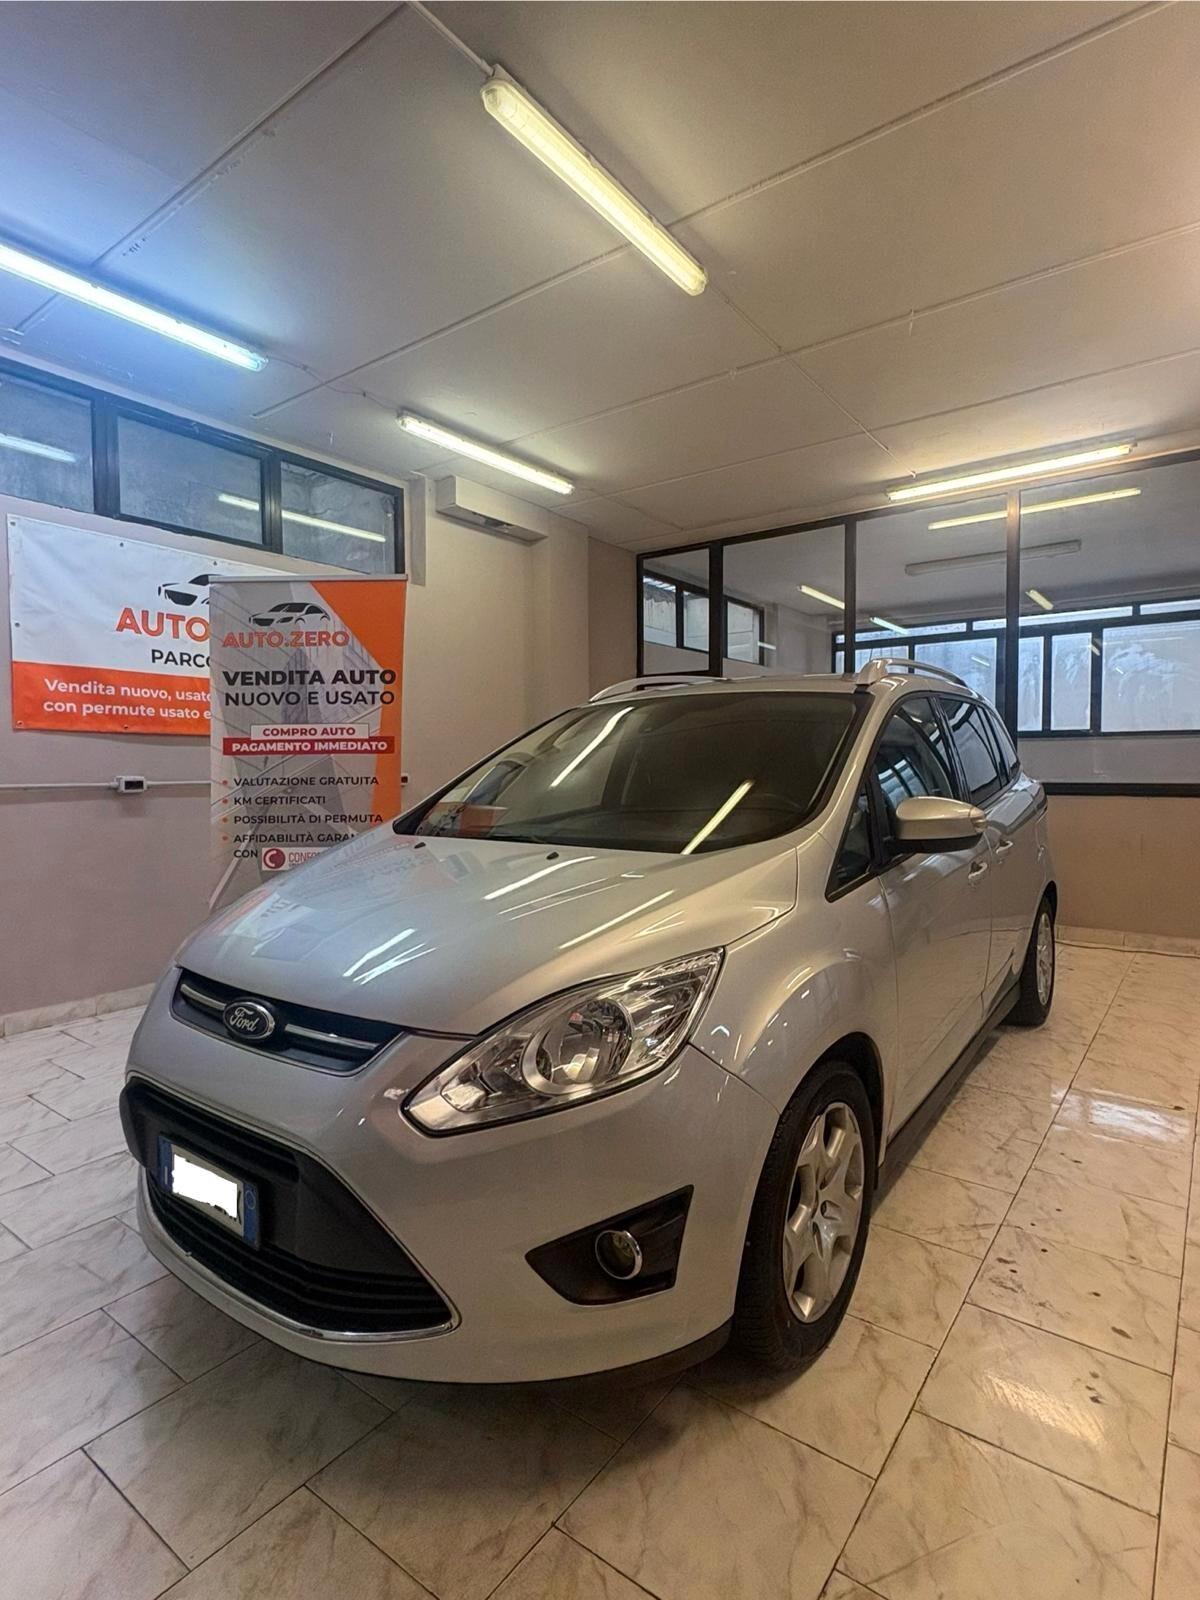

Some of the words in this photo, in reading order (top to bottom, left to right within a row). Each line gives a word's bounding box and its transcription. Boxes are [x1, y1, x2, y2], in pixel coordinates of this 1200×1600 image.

[116, 607, 210, 642] AUTO
[222, 631, 349, 648] AUTO.ZERO
[222, 670, 325, 686] VENDITA
[332, 669, 396, 685] AUTO
[44, 678, 116, 696] Vendita
[120, 686, 172, 701] nuovo,
[225, 691, 301, 706] NUOVO
[308, 691, 319, 705] E
[325, 690, 395, 705] USATO
[43, 700, 77, 713] con
[82, 702, 155, 717] permute
[159, 707, 200, 719] usato
[262, 727, 318, 737] COMPRO
[321, 727, 356, 736] AUTO
[232, 742, 311, 752] PAGAMENTO
[314, 741, 388, 751] IMMEDIATO
[233, 777, 316, 787] VALUTAZIONE
[319, 776, 379, 786] GRATUITA
[234, 797, 252, 805] KM
[255, 796, 326, 805] CERTIFICATI
[234, 813, 305, 824] POSSIBILITÀ
[309, 815, 321, 823] DI
[324, 814, 383, 823] PERMUTA
[233, 832, 313, 843] AFFIDABILITÀ
[233, 850, 258, 858] CON
[229, 1007, 260, 1032] Ford
